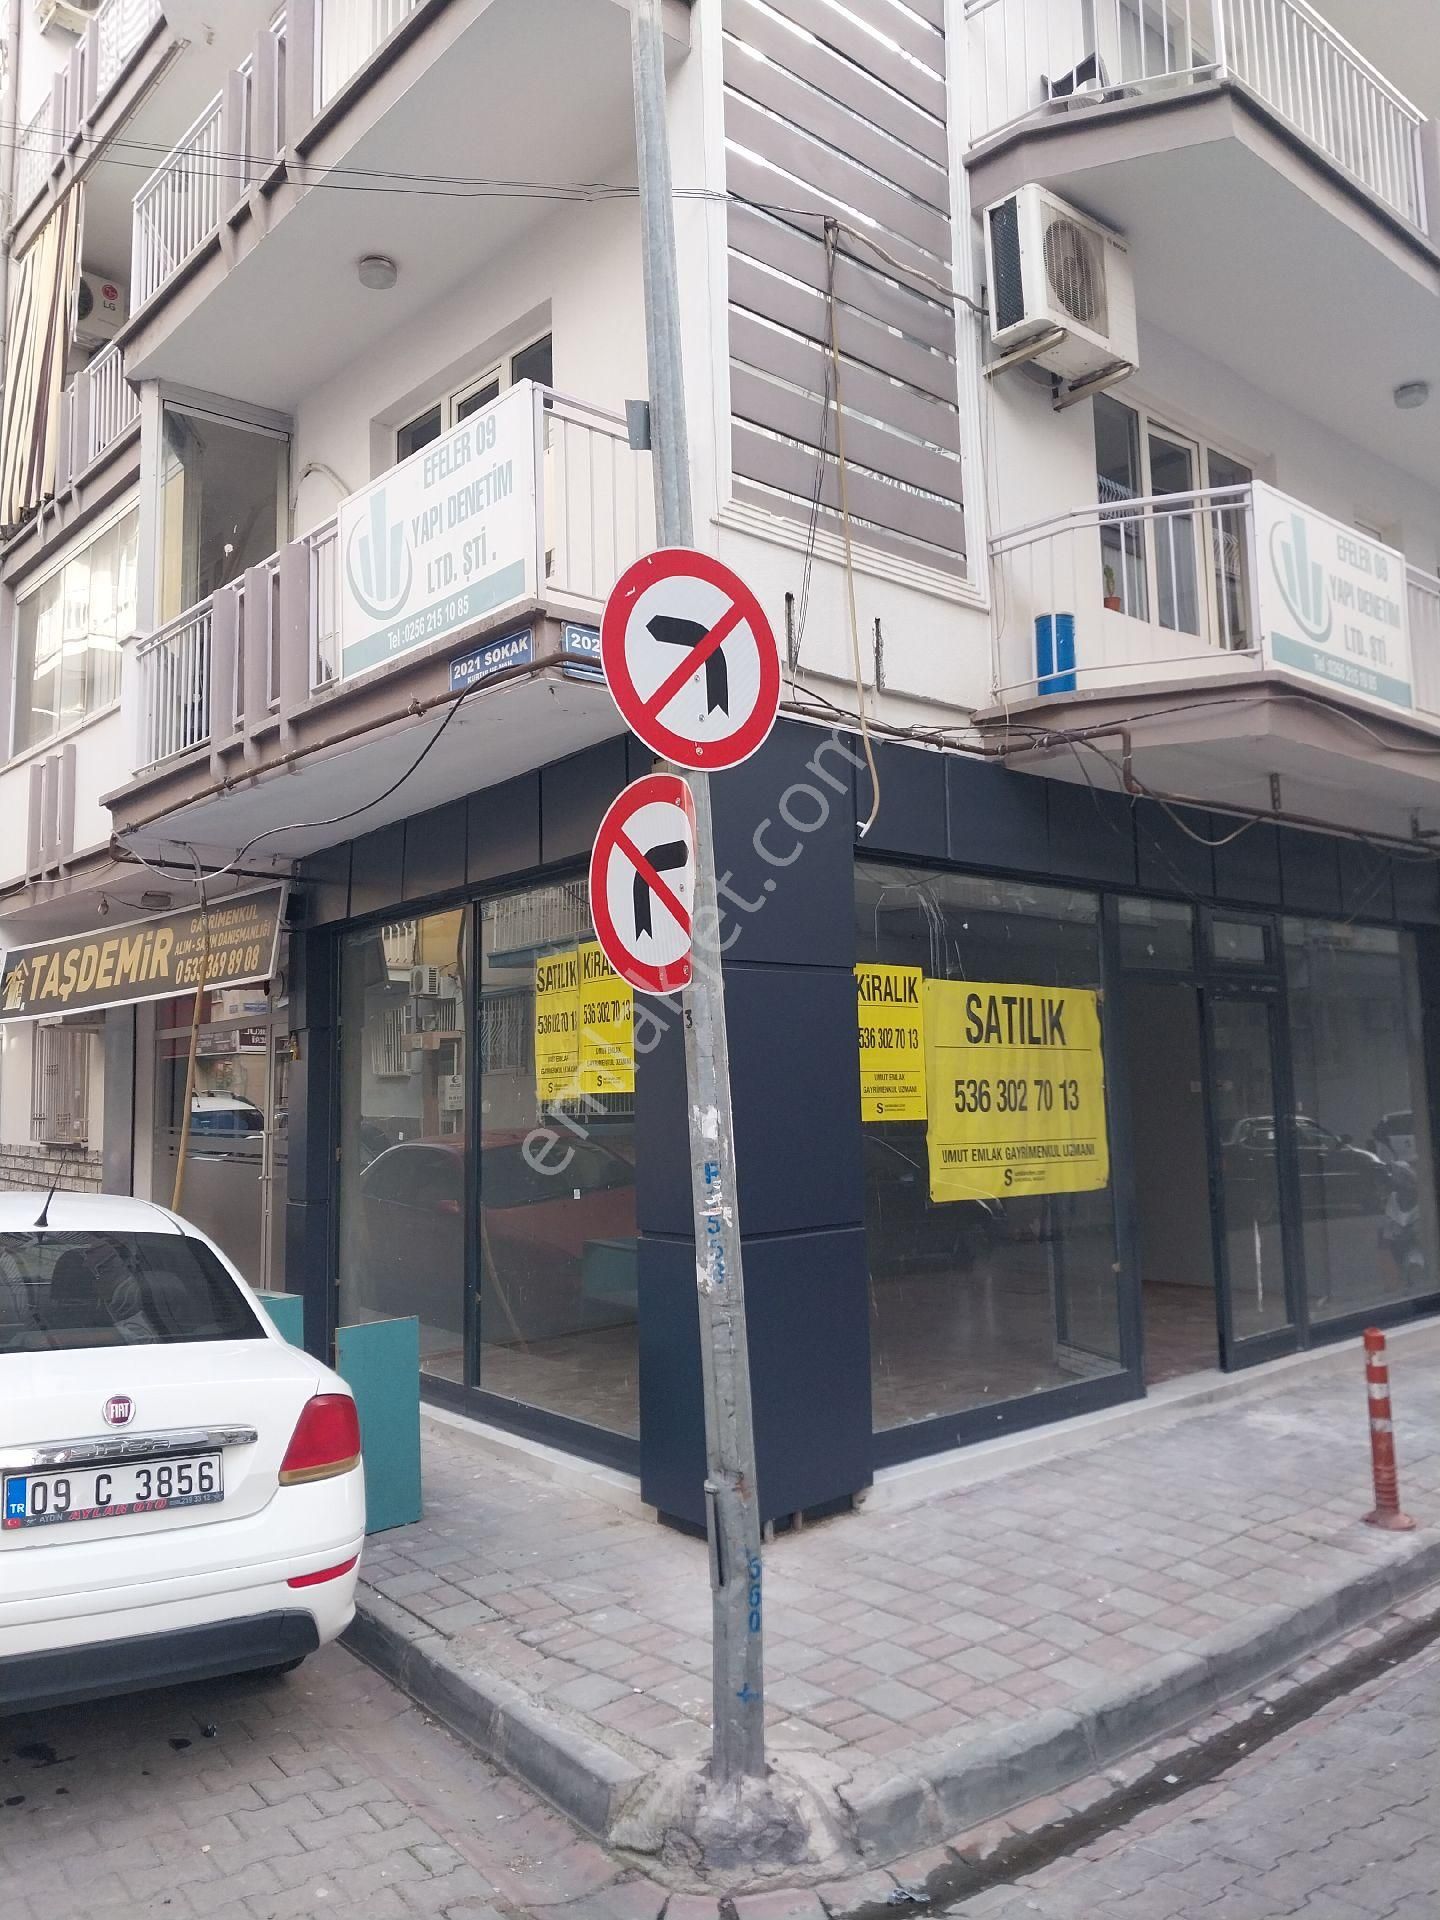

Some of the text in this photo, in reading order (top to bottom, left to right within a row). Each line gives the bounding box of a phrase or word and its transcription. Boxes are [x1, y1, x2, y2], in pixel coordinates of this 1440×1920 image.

[103, 300, 116, 311] LG
[423, 414, 497, 490] EFELER 09
[411, 460, 513, 548] YAPI DENETİM
[427, 551, 458, 595] LTD.
[1329, 573, 1355, 610] YAPI
[427, 608, 443, 633] 215
[445, 601, 456, 623] 10
[457, 595, 469, 617] 85
[453, 636, 529, 679] 2021 SOKAK
[571, 632, 601, 652] 202
[190, 904, 258, 934] GARİMENKUL
[174, 939, 192, 956] ALIM
[196, 933, 218, 952] SAIM
[218, 919, 272, 946] DANIŞMANLIĞI
[175, 959, 184, 985] 0
[205, 951, 228, 979] 369
[227, 947, 243, 975] 89
[243, 944, 260, 972] 08
[536, 960, 577, 993] SATILIK
[537, 1015, 552, 1035] 536
[561, 1012, 569, 1032] 70
[584, 999, 631, 1025] 536 302 70 13
[965, 992, 1067, 1046] SATILIK
[858, 1027, 919, 1049] 536 302 70 13
[954, 1079, 1080, 1113] 536 302 70 13
[942, 1143, 1095, 1163] UMUT EMLAK GAYRİMENKUL UZMANI
[110, 1402, 130, 1419] FIAT
[10, 1462, 214, 1515] TR 09 C 3856
